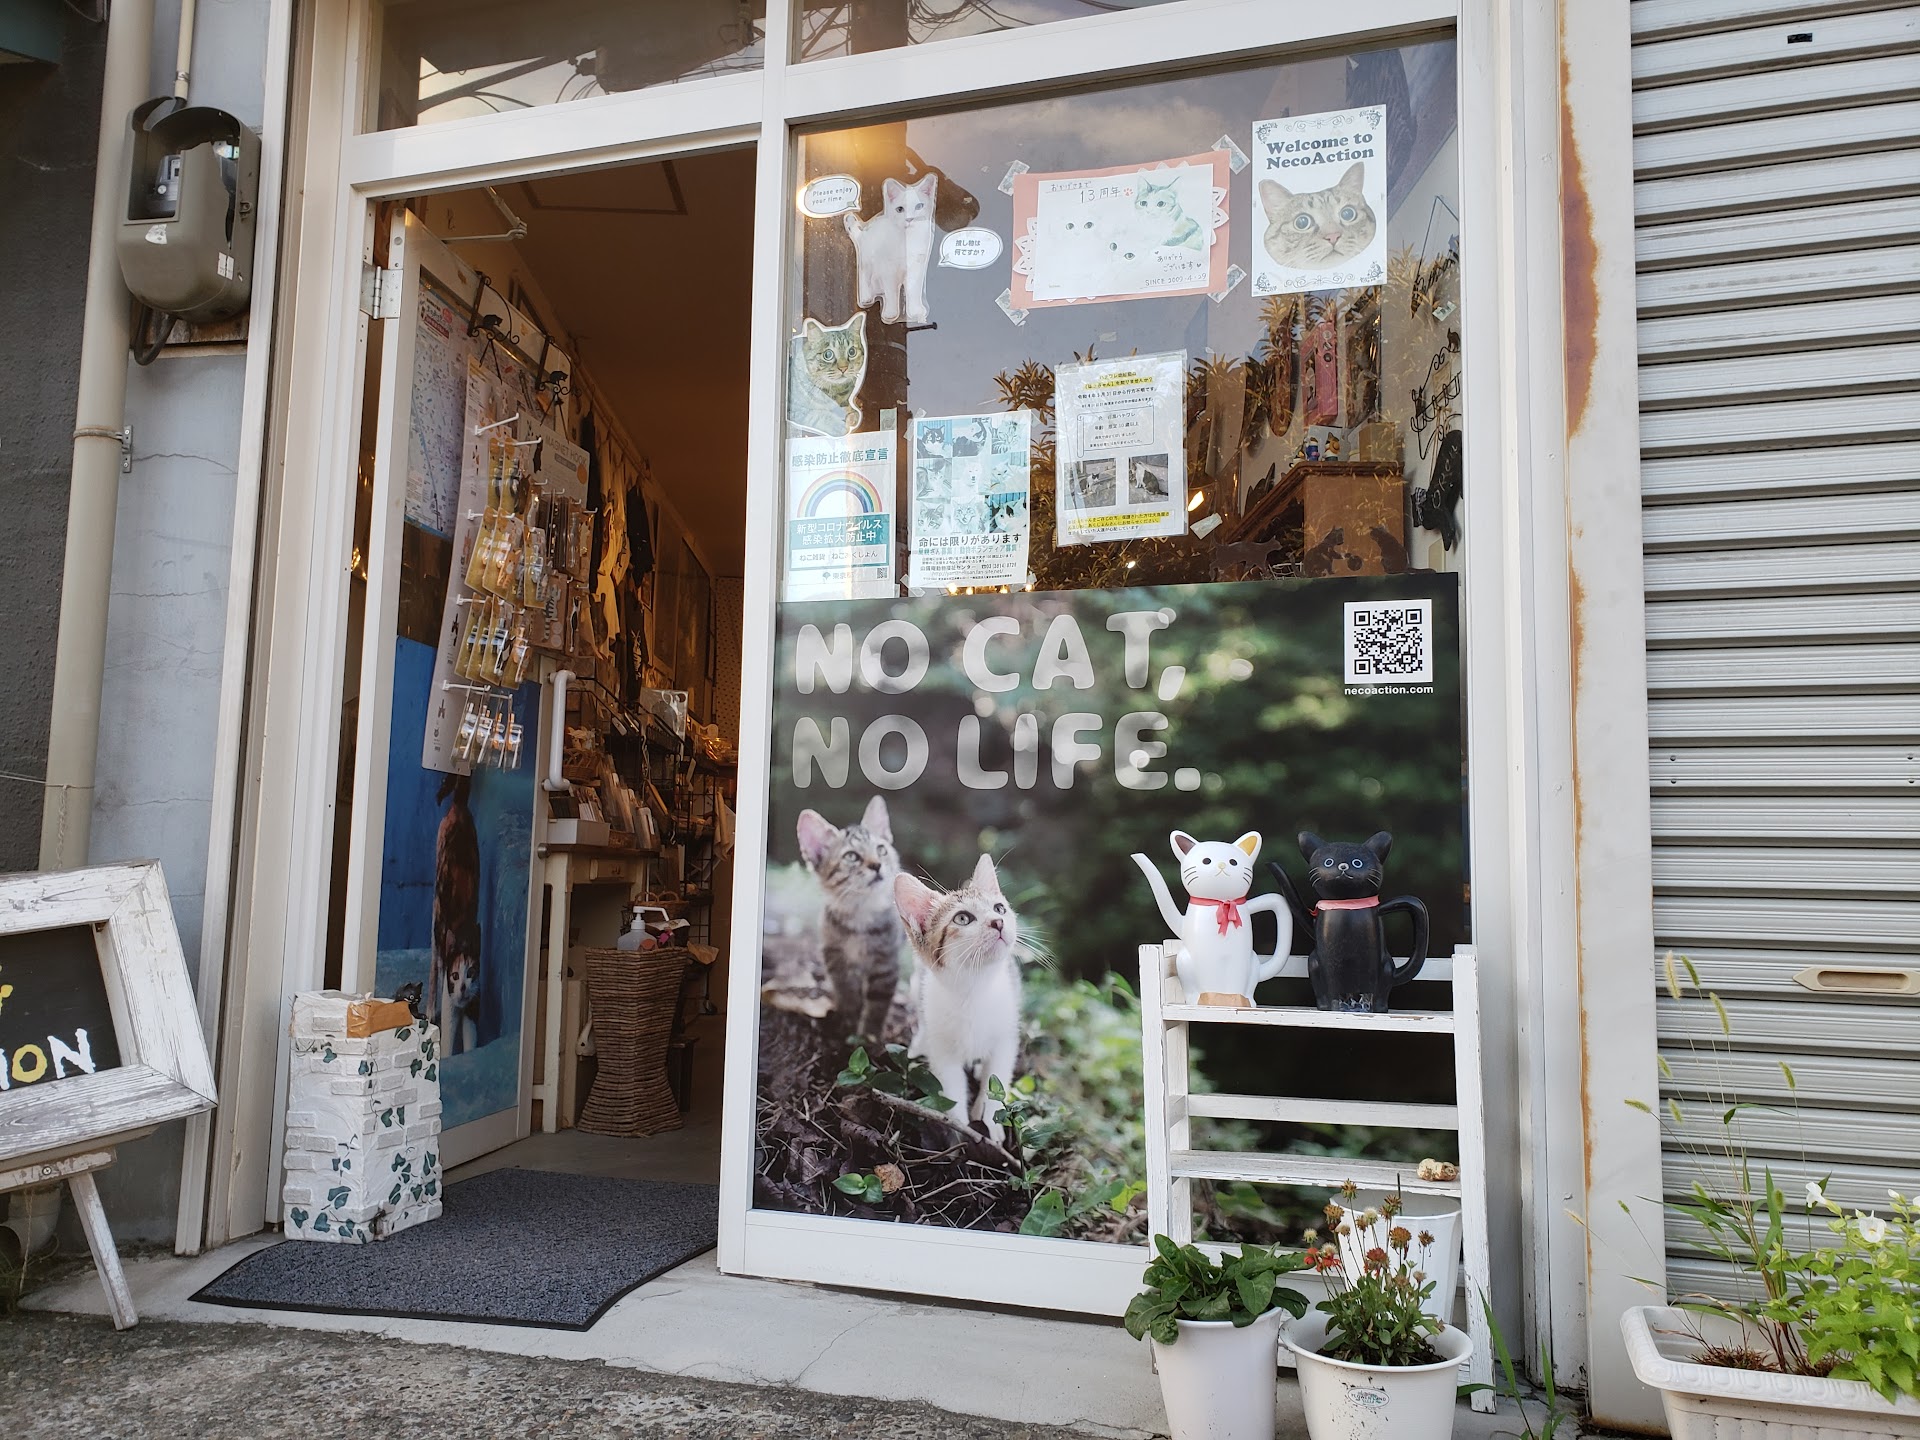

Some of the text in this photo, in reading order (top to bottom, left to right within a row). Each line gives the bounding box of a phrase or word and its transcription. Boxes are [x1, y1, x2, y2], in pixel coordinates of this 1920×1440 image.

[1266, 132, 1373, 155] Welcome to
[1266, 148, 1374, 170] NecoAction
[812, 187, 853, 197] Please enjoy
[1080, 186, 1121, 204] 13周年
[811, 198, 827, 206] your
[1145, 278, 1165, 287] SINCE
[791, 447, 889, 468] 感染防止徹底宣言
[796, 518, 883, 535] 新型コロナウイルス
[802, 530, 877, 546] 感染拡大防止中
[918, 533, 1022, 547] 命には限りがあります
[795, 611, 1187, 701] NO CAT,
[1344, 685, 1434, 696] necoaction.com
[792, 711, 1201, 792] NO LIFE.
